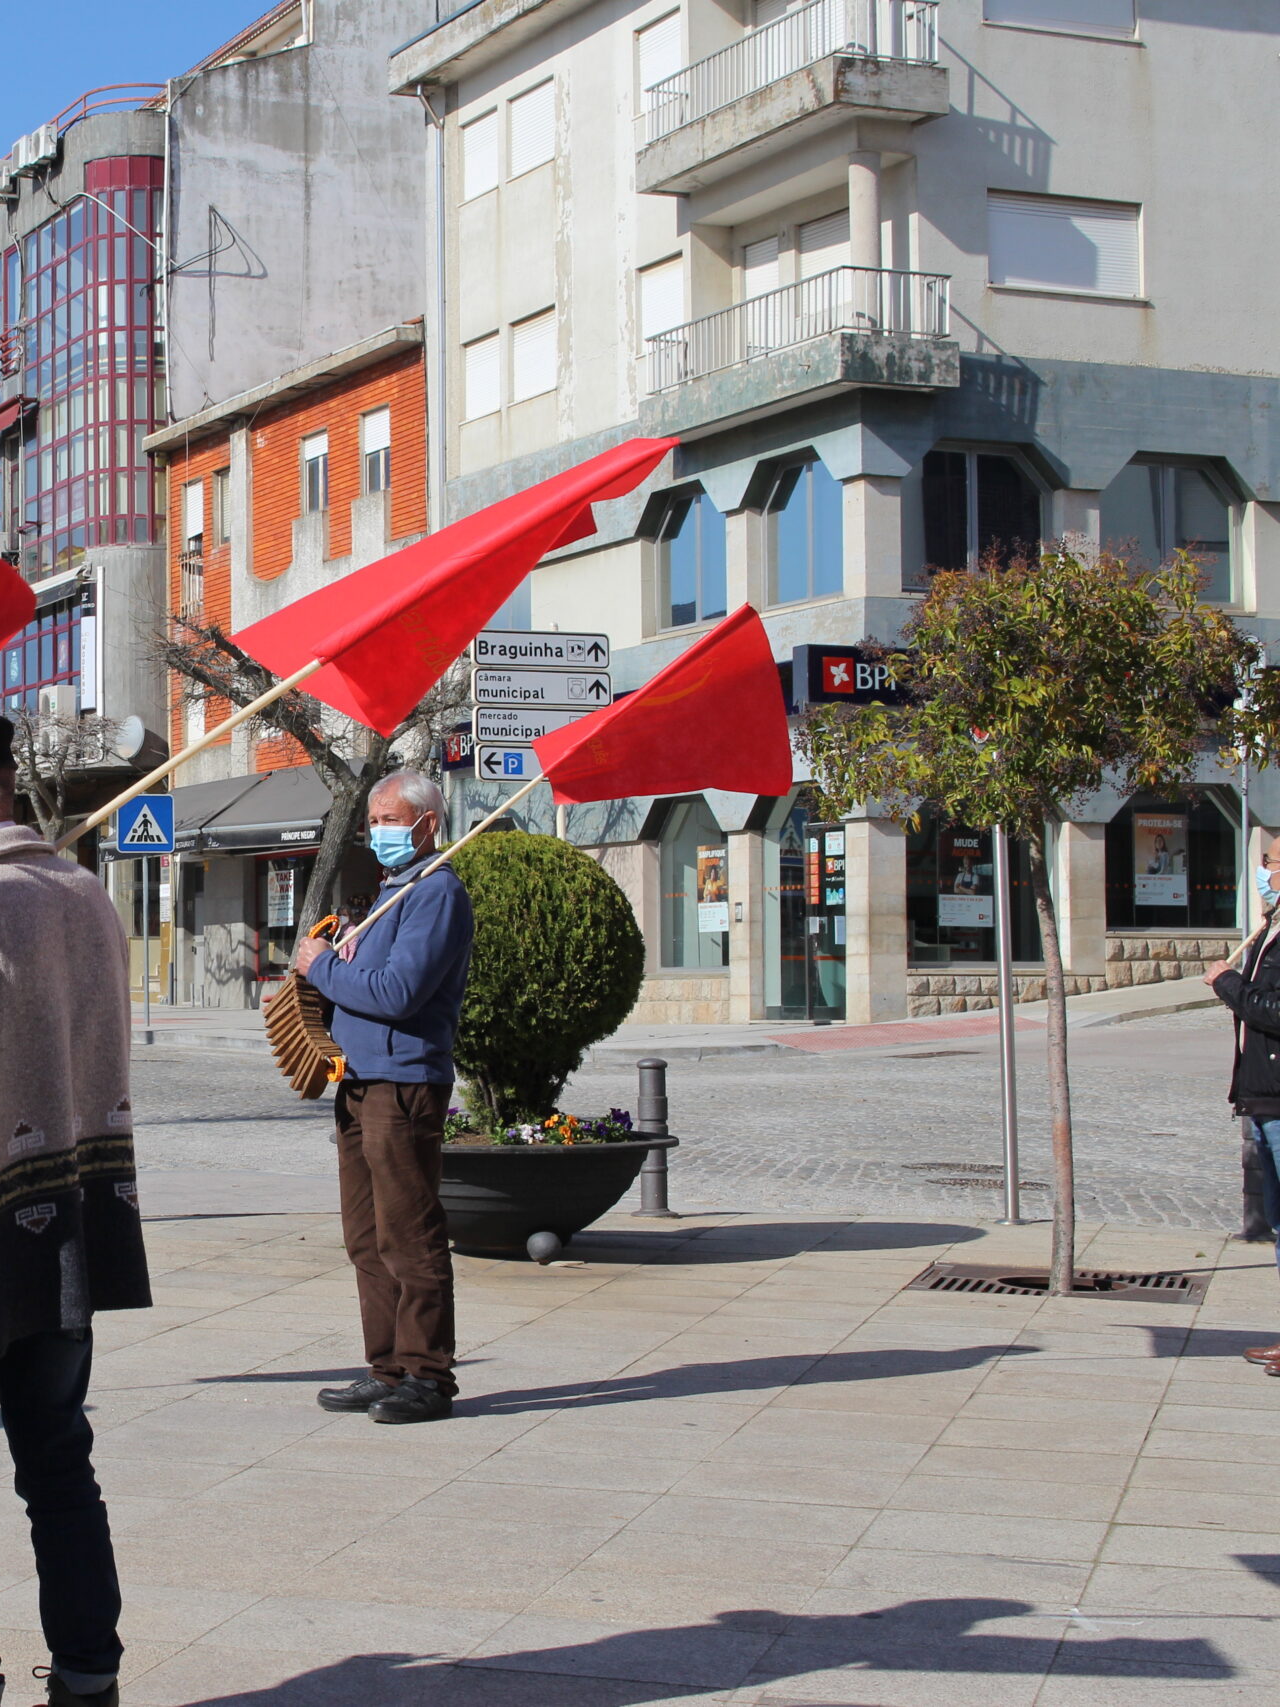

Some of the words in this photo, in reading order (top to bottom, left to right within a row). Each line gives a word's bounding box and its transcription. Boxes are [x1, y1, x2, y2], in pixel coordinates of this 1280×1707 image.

[478, 640, 564, 659] Braguinha
[478, 687, 545, 701] municipal
[480, 712, 518, 721] mercado
[480, 725, 546, 739] municipal
[1138, 819, 1183, 828] PROTEJA-SE
[301, 830, 316, 840] NEGRO
[953, 838, 979, 848] MUDE
[833, 859, 845, 871] BPI
[275, 871, 293, 882] TAKE
